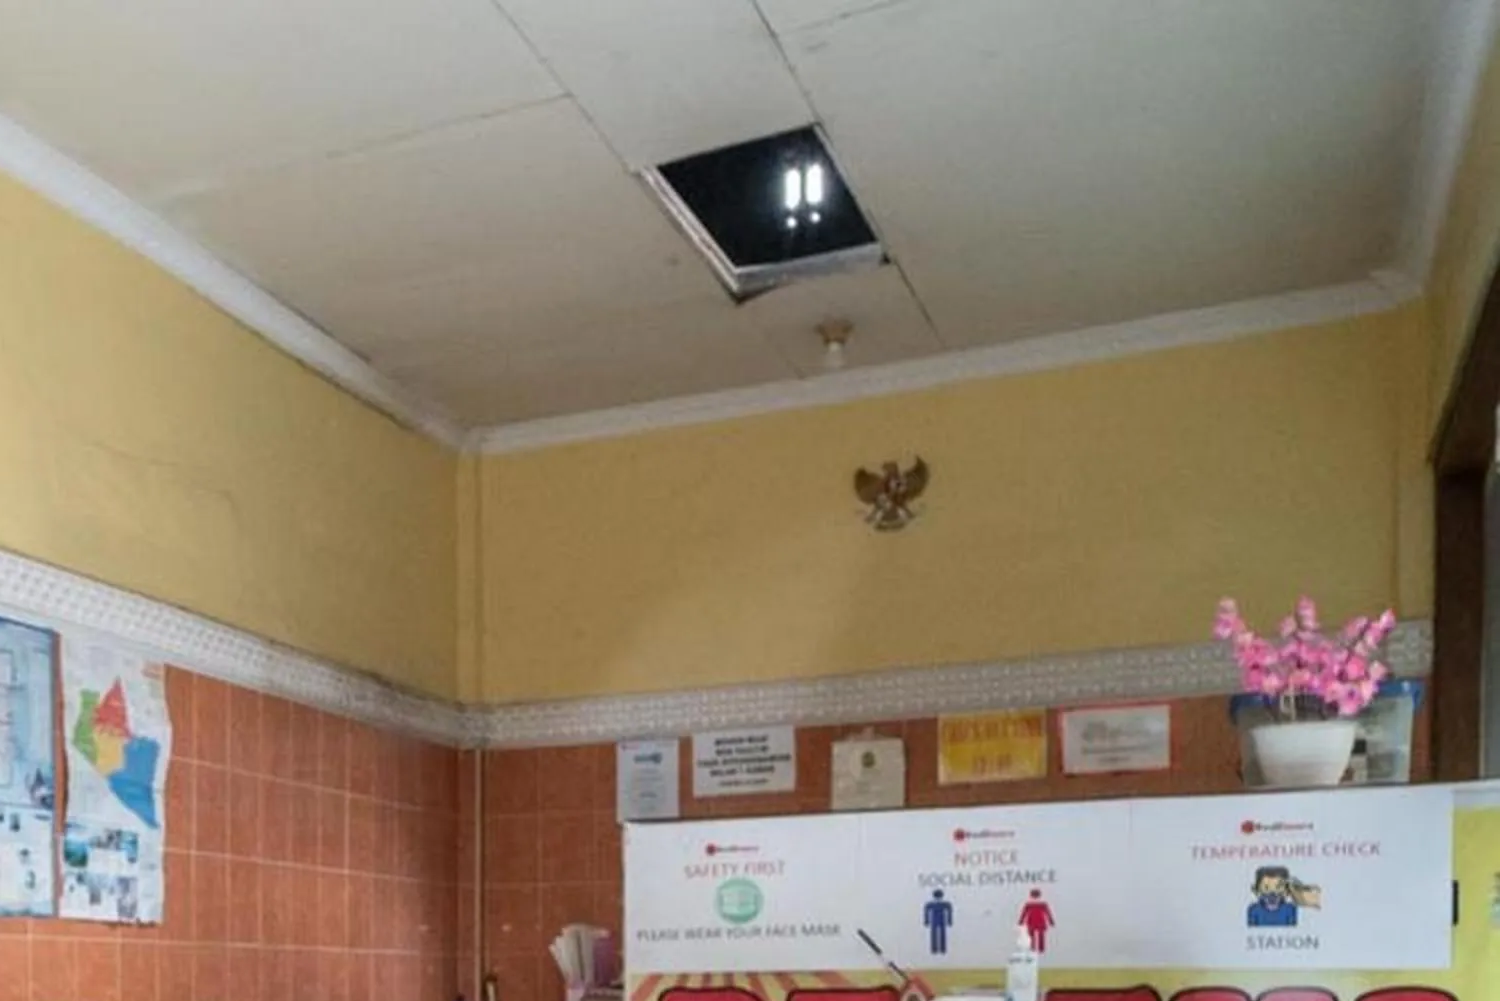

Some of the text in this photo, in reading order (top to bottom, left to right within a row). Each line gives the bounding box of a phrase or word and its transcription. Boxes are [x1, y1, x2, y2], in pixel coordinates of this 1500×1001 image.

[954, 849, 1018, 867] NOTICE
[1190, 839, 1381, 861] TEMPERATURE CHECK
[684, 860, 786, 879] SAFETY FIRST
[918, 869, 1057, 888] SOCIAL DISTANCE
[637, 929, 680, 942] PLEASE
[765, 924, 798, 939] FACE
[801, 923, 841, 938] MASK
[1245, 935, 1320, 951] STATION
